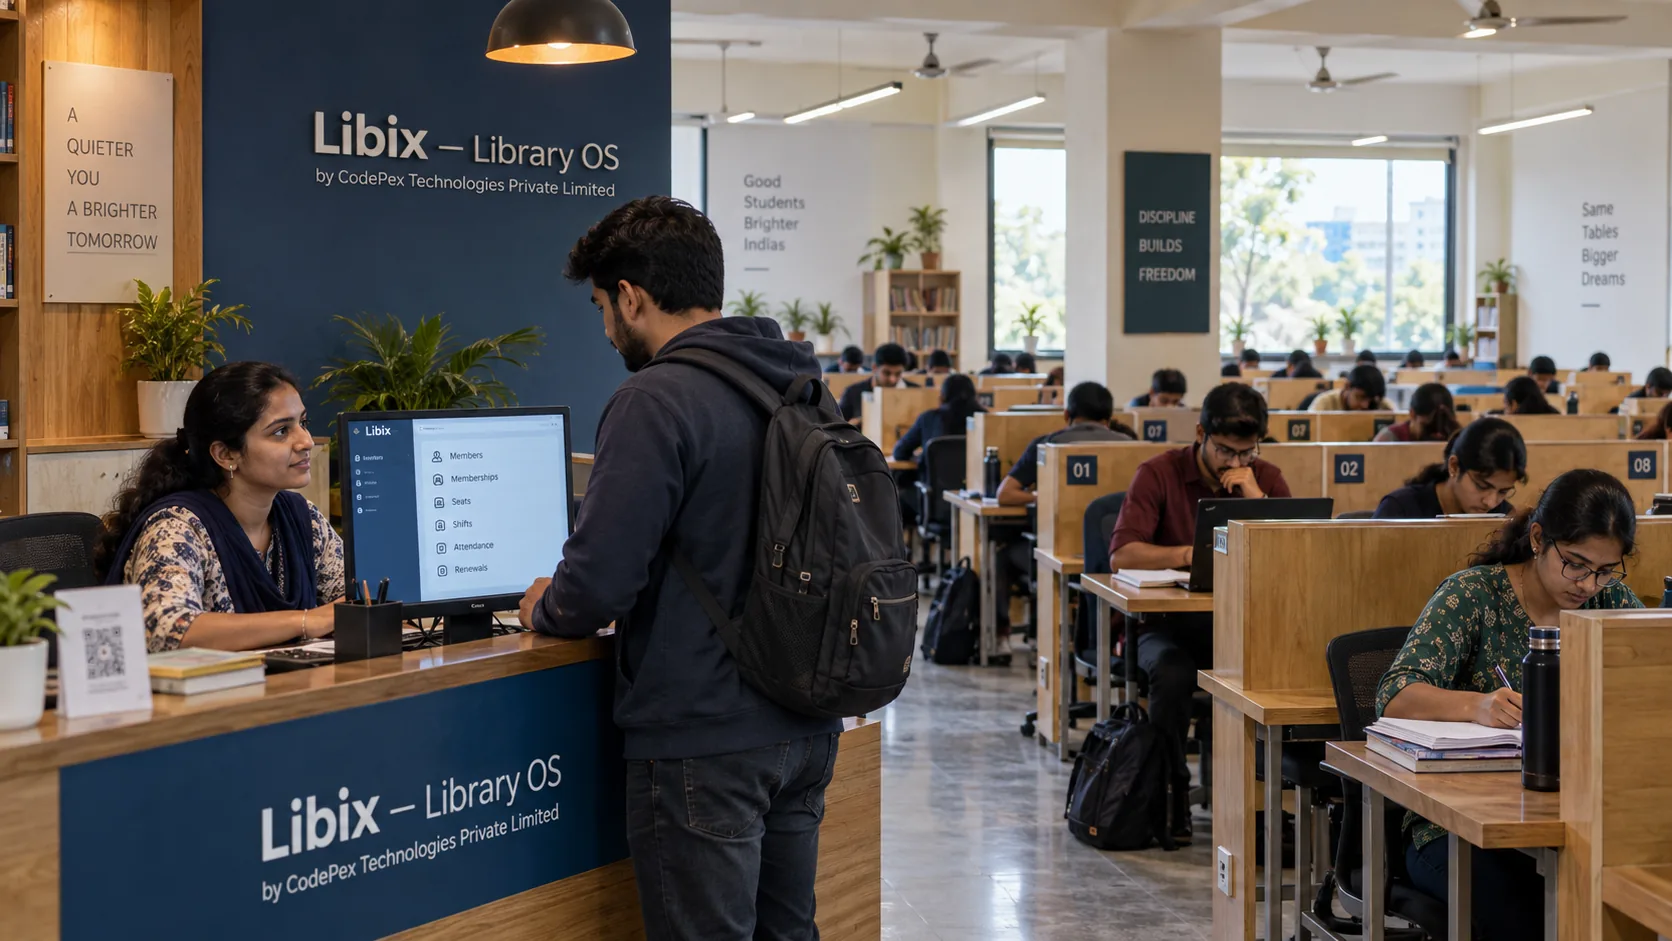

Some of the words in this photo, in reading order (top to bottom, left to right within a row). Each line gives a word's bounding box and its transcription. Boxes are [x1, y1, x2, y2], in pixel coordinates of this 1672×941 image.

[67, 107, 78, 122] A
[67, 138, 134, 157] QUIETER
[314, 110, 428, 160] Libix
[474, 134, 574, 174] Library
[581, 142, 620, 170] OS
[67, 169, 100, 186] YOU
[316, 168, 334, 186] by
[338, 169, 405, 187] CodePex
[408, 173, 504, 194] Technologies
[509, 179, 558, 195] Private
[562, 182, 615, 197] Limited
[744, 174, 781, 188] Good
[744, 194, 805, 209] Students
[67, 200, 78, 216] A
[83, 201, 157, 219] BRIGHTER
[1139, 210, 1196, 224] DISCIPLINE
[1582, 202, 1614, 217] Same
[744, 216, 799, 233] Brighter
[1582, 224, 1618, 239] Tables
[67, 232, 158, 250] TOMORROW
[744, 237, 786, 251] Indias
[1139, 238, 1183, 252] BUILDS
[1582, 248, 1619, 266] Bigger
[1139, 268, 1196, 282] FREEDOM
[1582, 272, 1625, 286] Dreams
[366, 425, 391, 436] Libix
[1292, 424, 1306, 437] 07
[450, 452, 483, 460] Members
[1073, 462, 1090, 478] 01
[1340, 461, 1358, 476] 02
[1634, 457, 1651, 473] 08
[451, 473, 498, 483] Memberships
[452, 498, 471, 506] Seats
[453, 520, 473, 529] Shifts
[454, 542, 494, 551] Attendance
[455, 564, 488, 574] Renewals
[262, 787, 380, 862] Libix
[426, 772, 521, 819] Library
[527, 754, 562, 792] OS
[262, 881, 282, 903] by
[286, 861, 356, 894] CodePex
[360, 835, 456, 874] Technologies
[460, 819, 507, 846] Private
[511, 803, 559, 832] Limited
